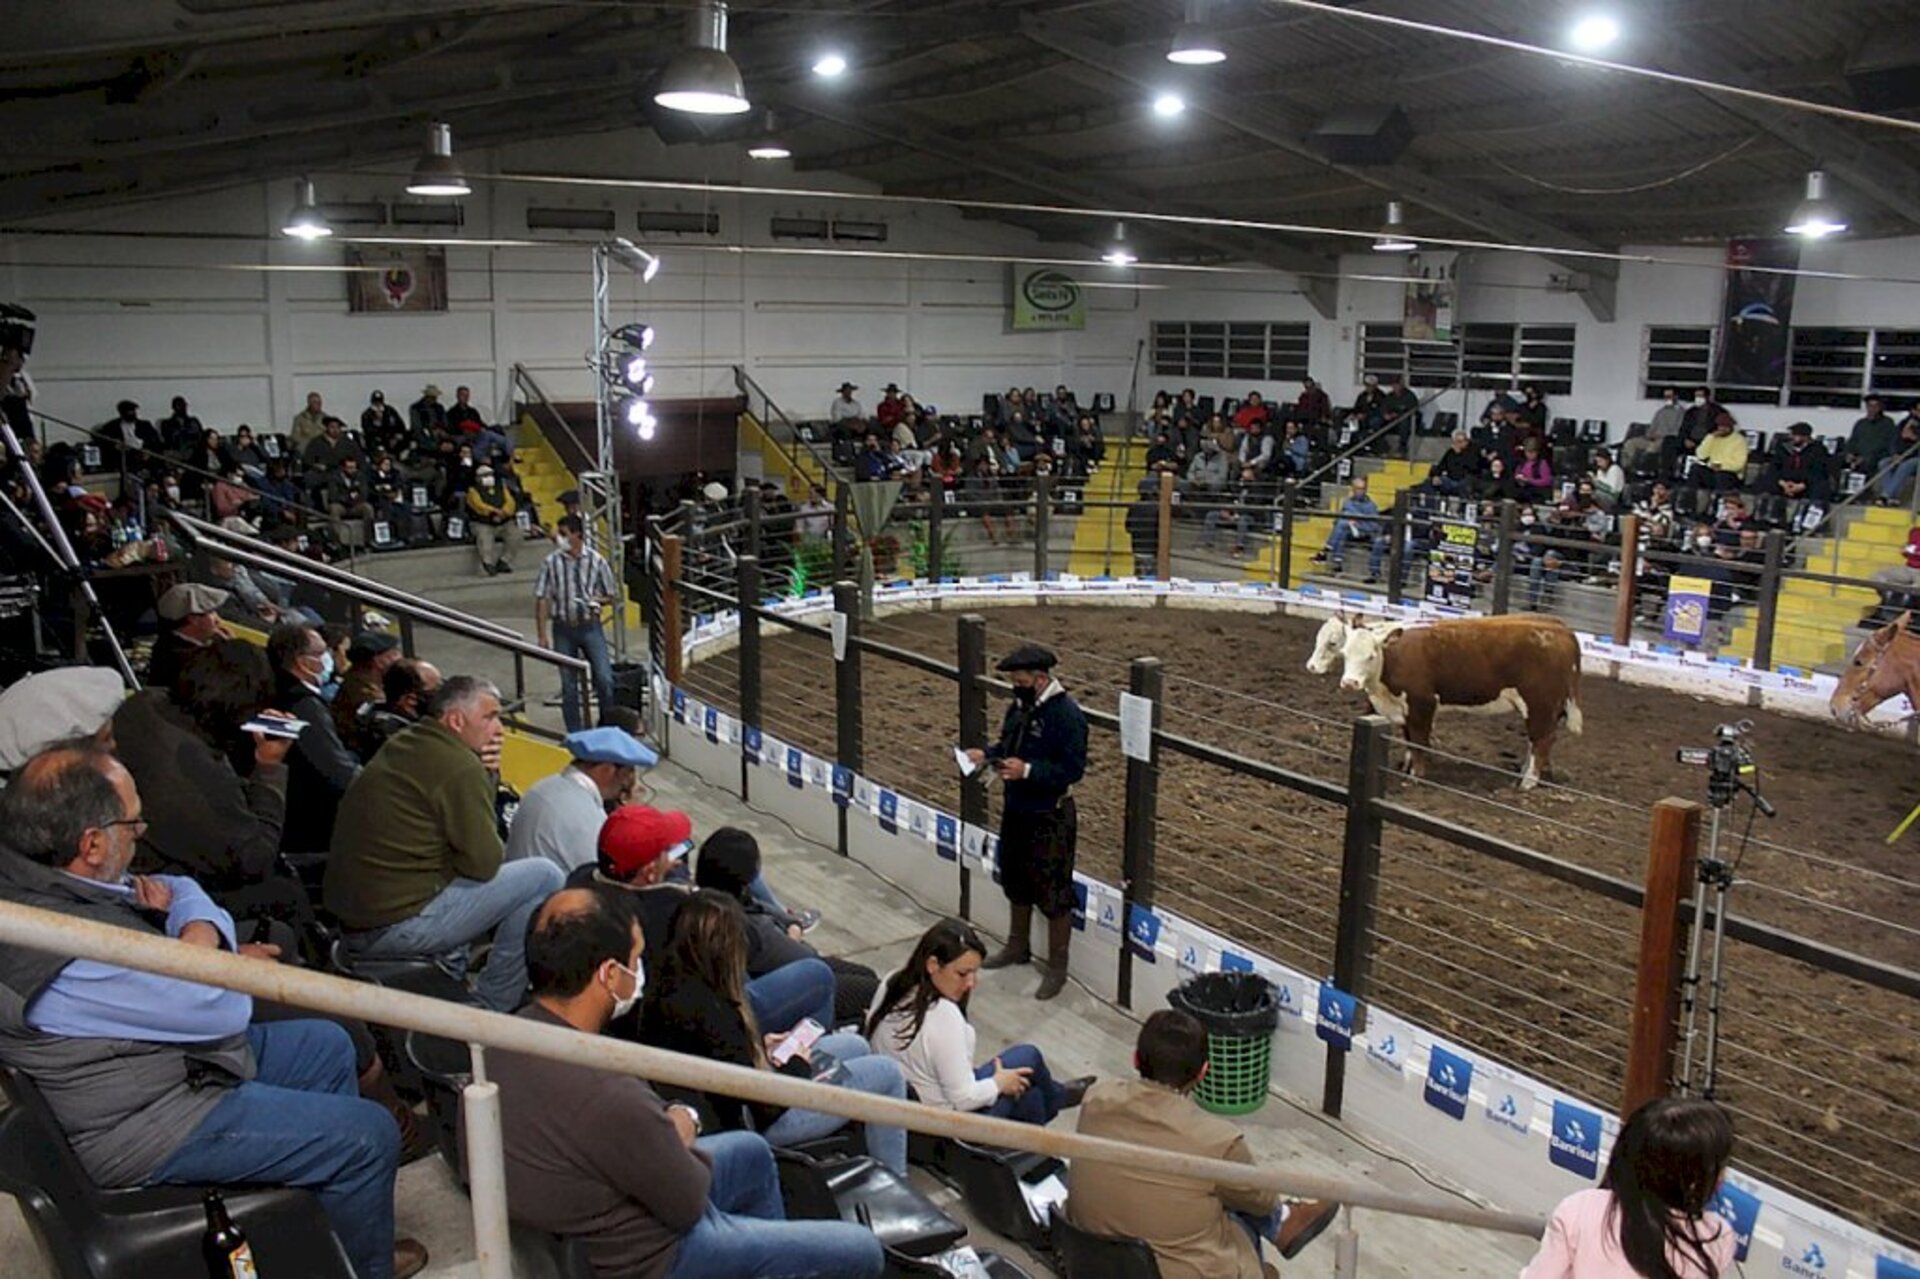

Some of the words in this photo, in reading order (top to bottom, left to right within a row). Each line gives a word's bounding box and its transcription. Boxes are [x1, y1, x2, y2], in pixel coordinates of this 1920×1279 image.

[1426, 1077, 1469, 1105] Banrisul
[1485, 1107, 1529, 1134] Banrisul
[1551, 1135, 1597, 1163] Banrisul
[1781, 1255, 1828, 1279] Banri
